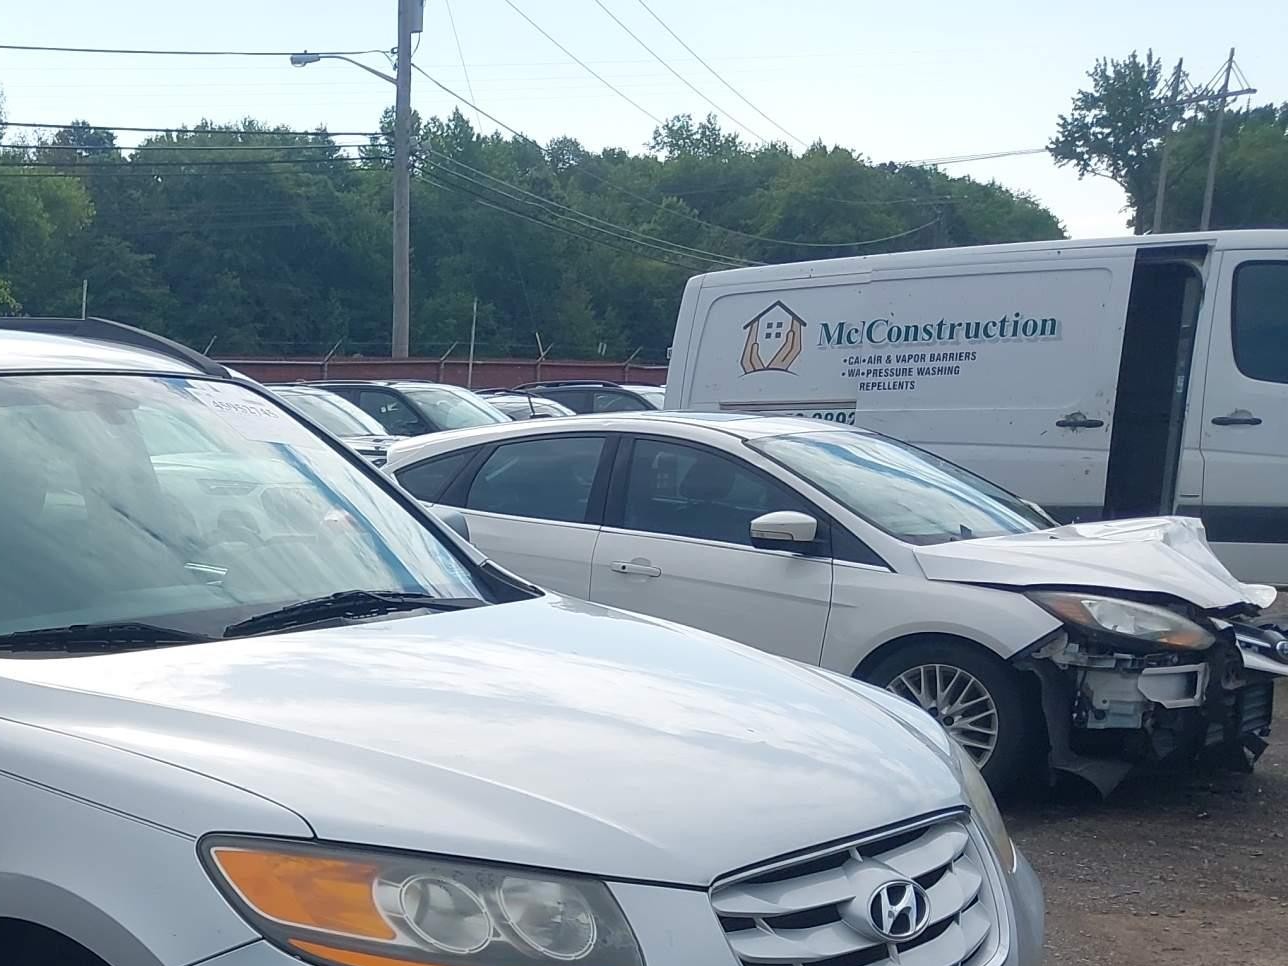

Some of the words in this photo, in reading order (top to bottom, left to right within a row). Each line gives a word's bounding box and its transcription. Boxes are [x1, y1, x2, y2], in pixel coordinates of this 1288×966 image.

[895, 353, 926, 364] VAPOR
[929, 352, 977, 363] BARRIERS
[917, 366, 961, 377] WASHING
[859, 380, 915, 391] REPELLENTS
